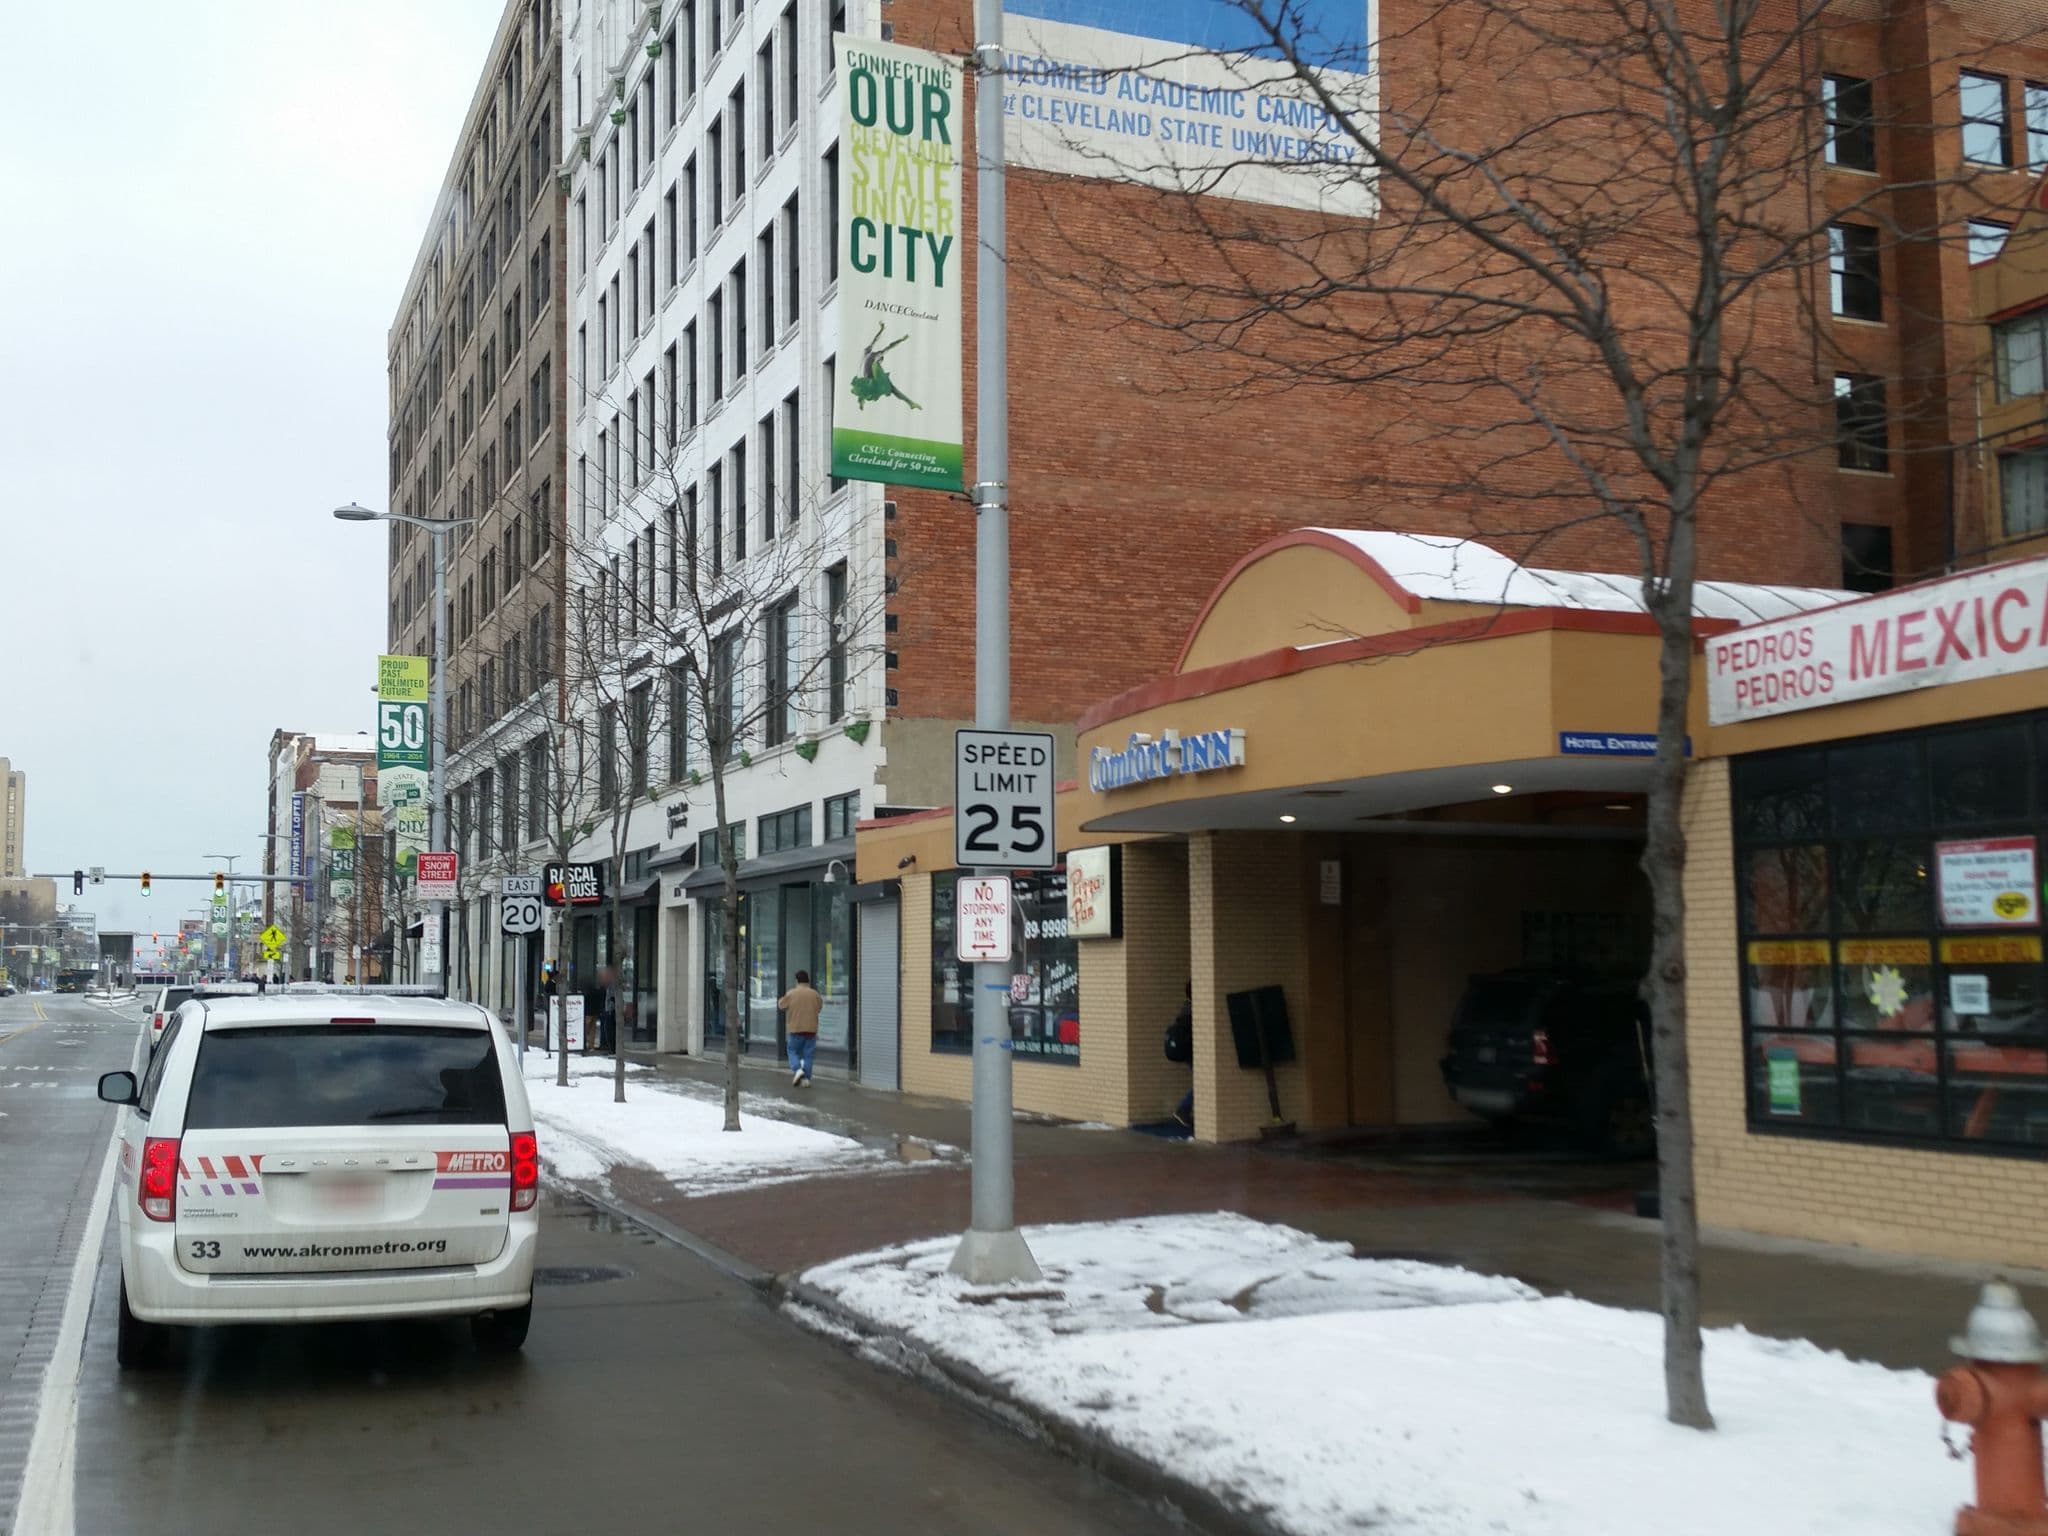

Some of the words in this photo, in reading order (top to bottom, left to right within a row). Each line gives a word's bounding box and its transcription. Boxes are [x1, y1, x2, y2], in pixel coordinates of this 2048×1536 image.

[847, 50, 953, 89] CONNECTING
[1003, 54, 1107, 96] NEOMED
[1117, 72, 1245, 119] ACADEMIC
[849, 67, 951, 145] OUR
[1022, 94, 1152, 137] CLEVELAND
[1160, 116, 1223, 149] STATE
[1232, 127, 1356, 162] UNIVERSITY
[850, 123, 954, 163] CLEVELAND
[851, 144, 953, 208] STATE
[852, 183, 953, 237] UNIVER
[850, 216, 953, 288] CITY
[861, 444, 885, 456] CSU:
[887, 447, 937, 464] Connecting
[848, 454, 893, 468] Cleveland
[893, 459, 908, 471] for
[910, 462, 921, 471] 50
[921, 464, 948, 475] years.
[1716, 626, 1814, 675] PEDROS
[381, 660, 409, 670] PROUD
[381, 670, 403, 679] PAST.
[381, 679, 424, 688] UNLIMITED
[381, 688, 414, 697] FUTURE.
[1735, 661, 1834, 709] PEDROS
[381, 704, 424, 749] 50
[964, 744, 1046, 766] SPEED
[1088, 732, 1173, 793] Comfort
[1179, 728, 1232, 774] INN
[974, 772, 1037, 794] LIMIT
[293, 799, 302, 829] LOFTS
[398, 820, 425, 833] CITY
[964, 803, 1045, 853] 25
[421, 870, 452, 880] STREET
[424, 861, 451, 870] SNOW
[507, 880, 536, 891] EAST
[974, 887, 994, 902] NO
[213, 907, 226, 918] 50
[506, 905, 538, 925] 20
[962, 902, 1006, 916] STOPPING
[974, 918, 993, 928] ANY
[973, 930, 996, 942] TIME
[447, 1153, 506, 1171] METRO
[191, 1240, 221, 1259] 33
[243, 1239, 447, 1257] www.akronmetro.org
